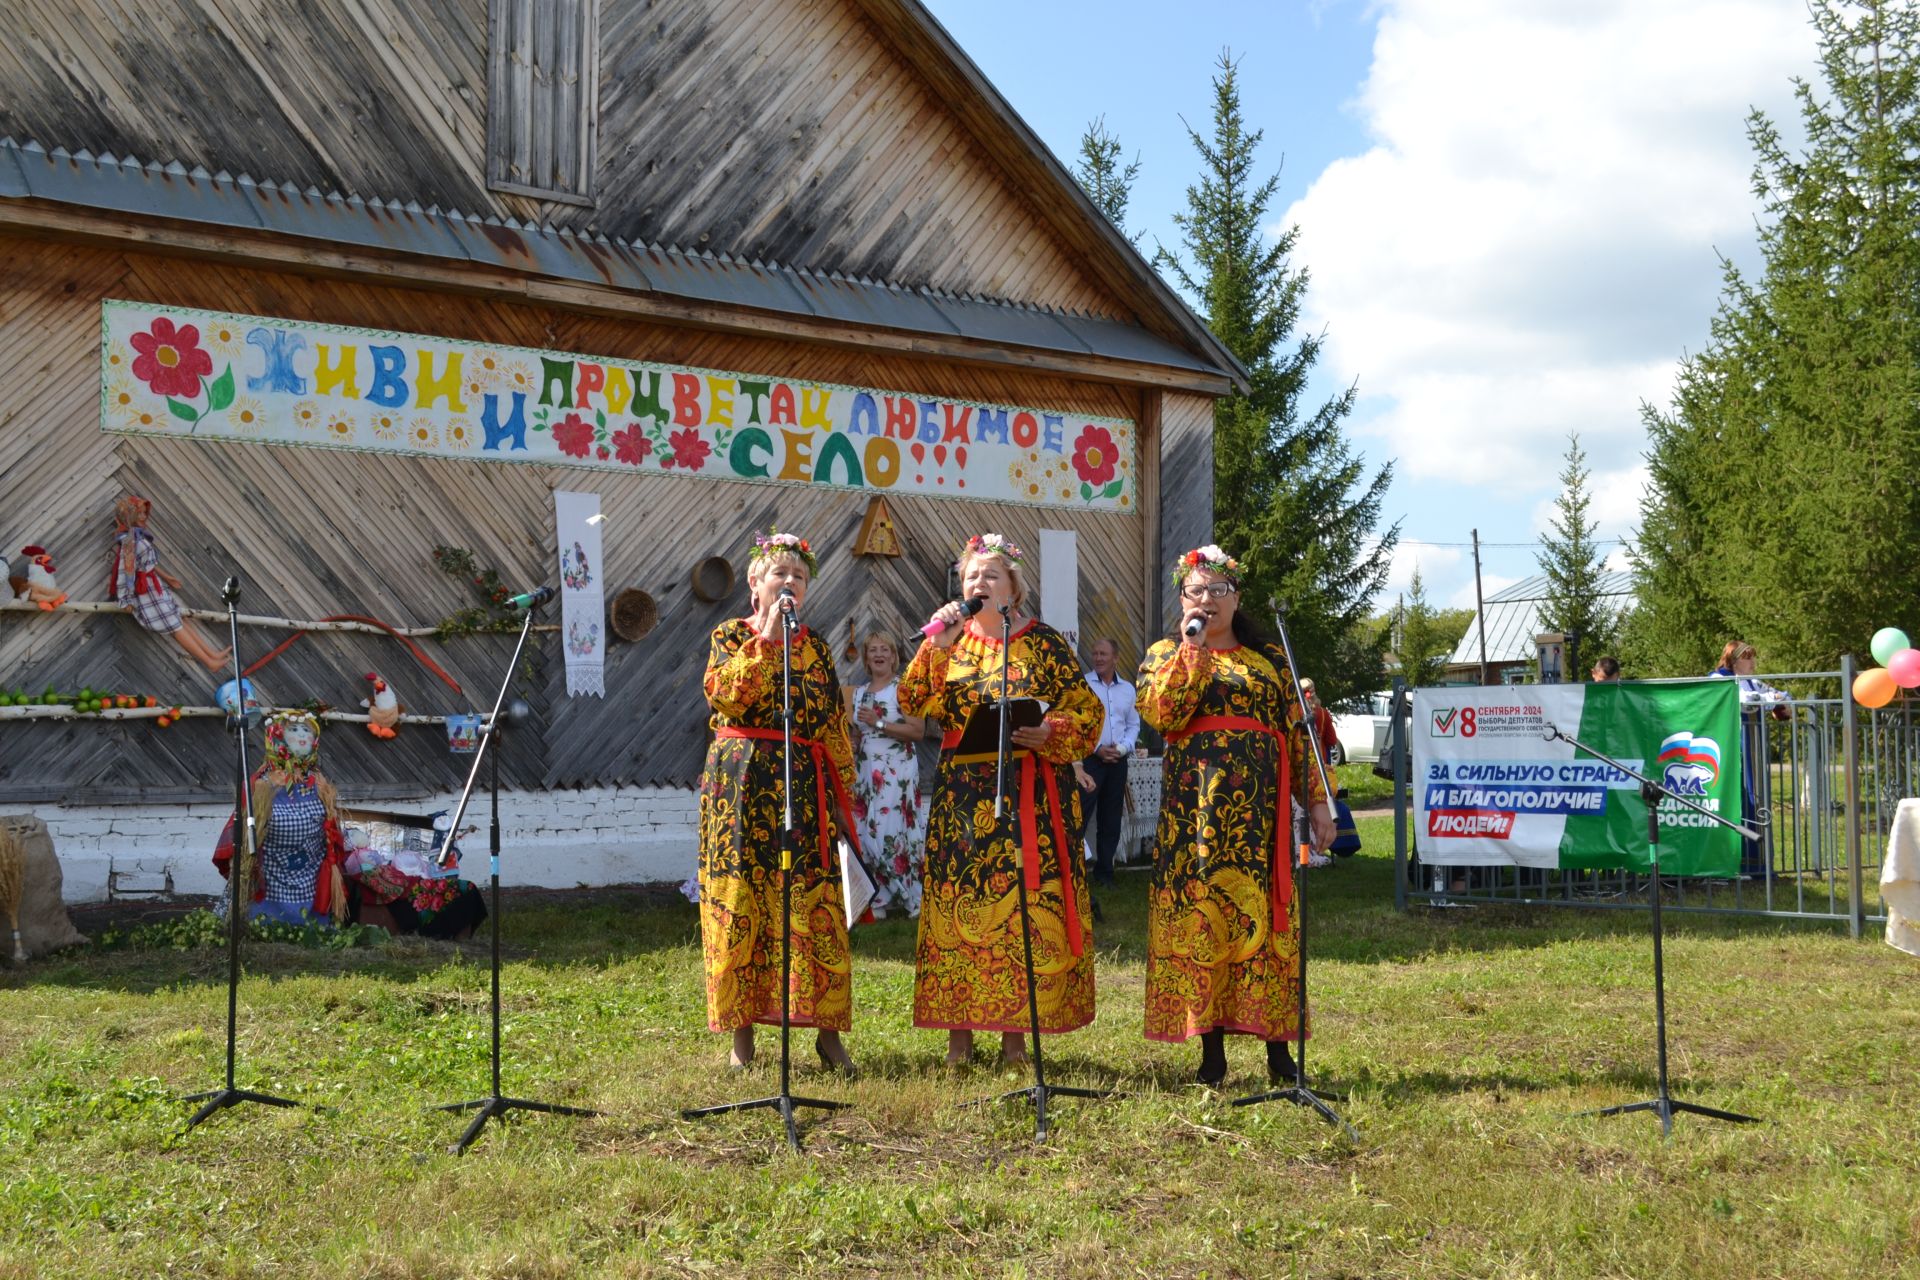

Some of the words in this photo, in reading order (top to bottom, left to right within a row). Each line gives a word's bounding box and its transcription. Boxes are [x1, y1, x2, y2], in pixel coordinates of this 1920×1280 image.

[245, 327, 468, 413] ЖИВИ
[481, 391, 528, 452] И
[847, 392, 1064, 455] ЛЮБИМОЕ
[1478, 706, 1520, 716] СЕНТЯБРЯ
[1523, 706, 1542, 715] 2024
[1460, 707, 1476, 738] 8
[1478, 717, 1506, 725] ВЫБОРЫ
[1508, 717, 1543, 725] ДЕПУТАТОВ
[1428, 765, 1450, 780] ЗА
[1455, 765, 1554, 782] СИЛЬНУЮ
[1559, 766, 1637, 782] СТРАНУ
[1429, 790, 1445, 806] И
[1448, 790, 1603, 810] БЛАГОПОЛУЧИЕ
[1432, 814, 1510, 834] ЛЮДЕЙ!
[1656, 813, 1720, 828] РОССИЯ
